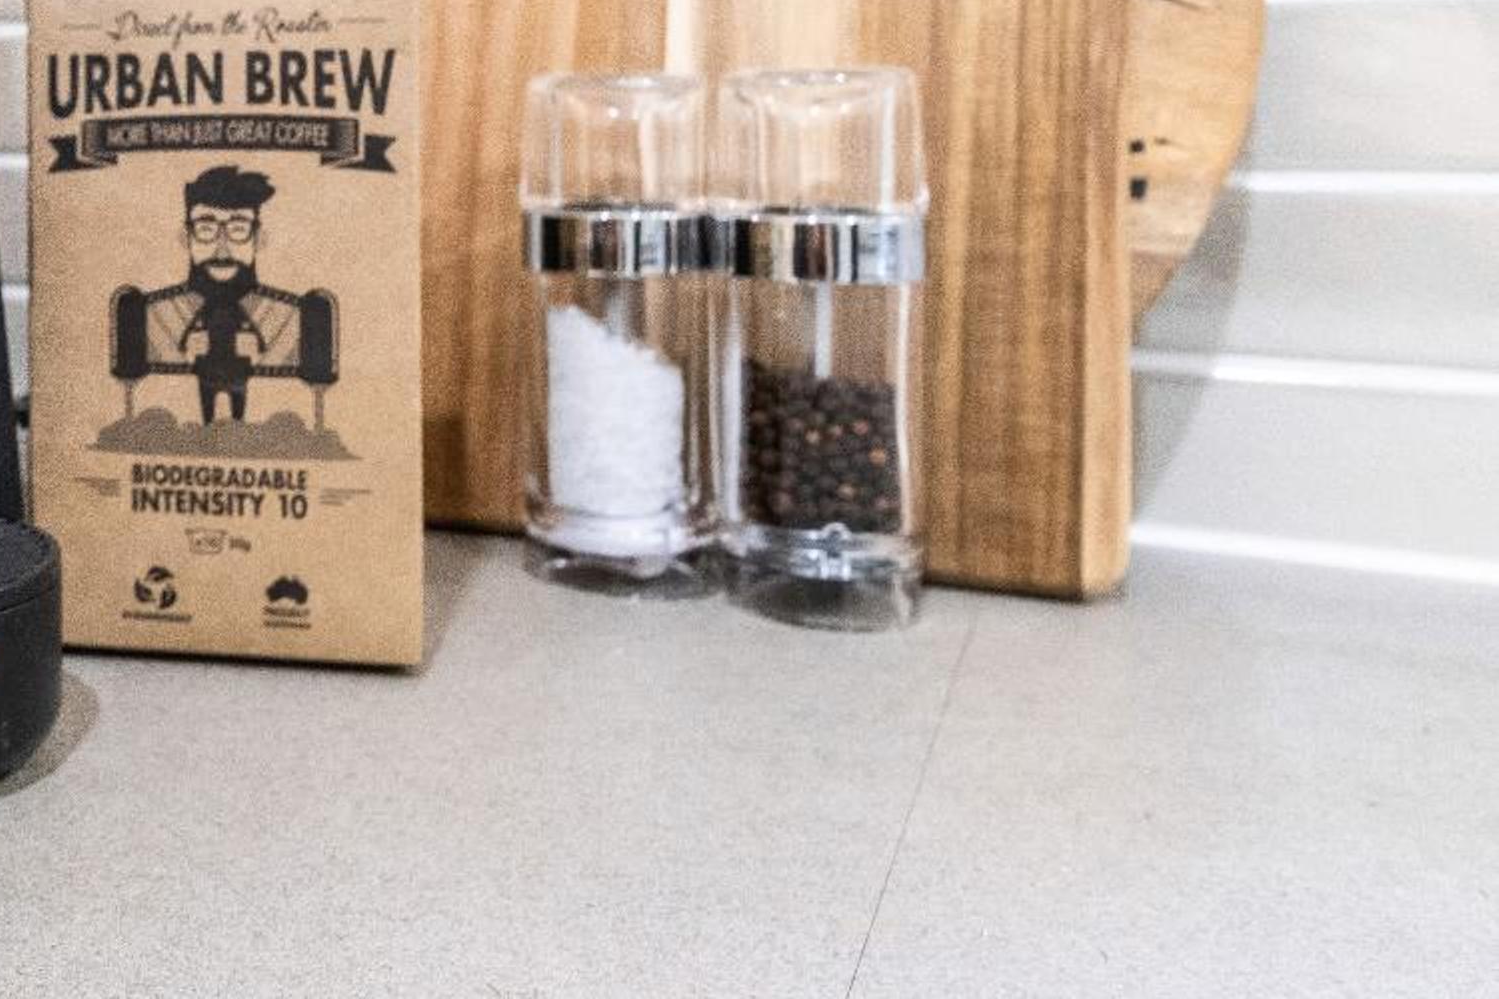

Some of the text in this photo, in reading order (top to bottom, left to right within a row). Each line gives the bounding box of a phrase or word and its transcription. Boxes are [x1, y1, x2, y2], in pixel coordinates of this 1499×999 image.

[220, 9, 247, 36] the
[47, 47, 397, 119] URBAN BREW
[226, 119, 273, 144] GREAT
[274, 120, 330, 148] COFFEE
[131, 463, 308, 491] BIODEGRADABLE
[131, 488, 308, 520] INTENSITY 10
